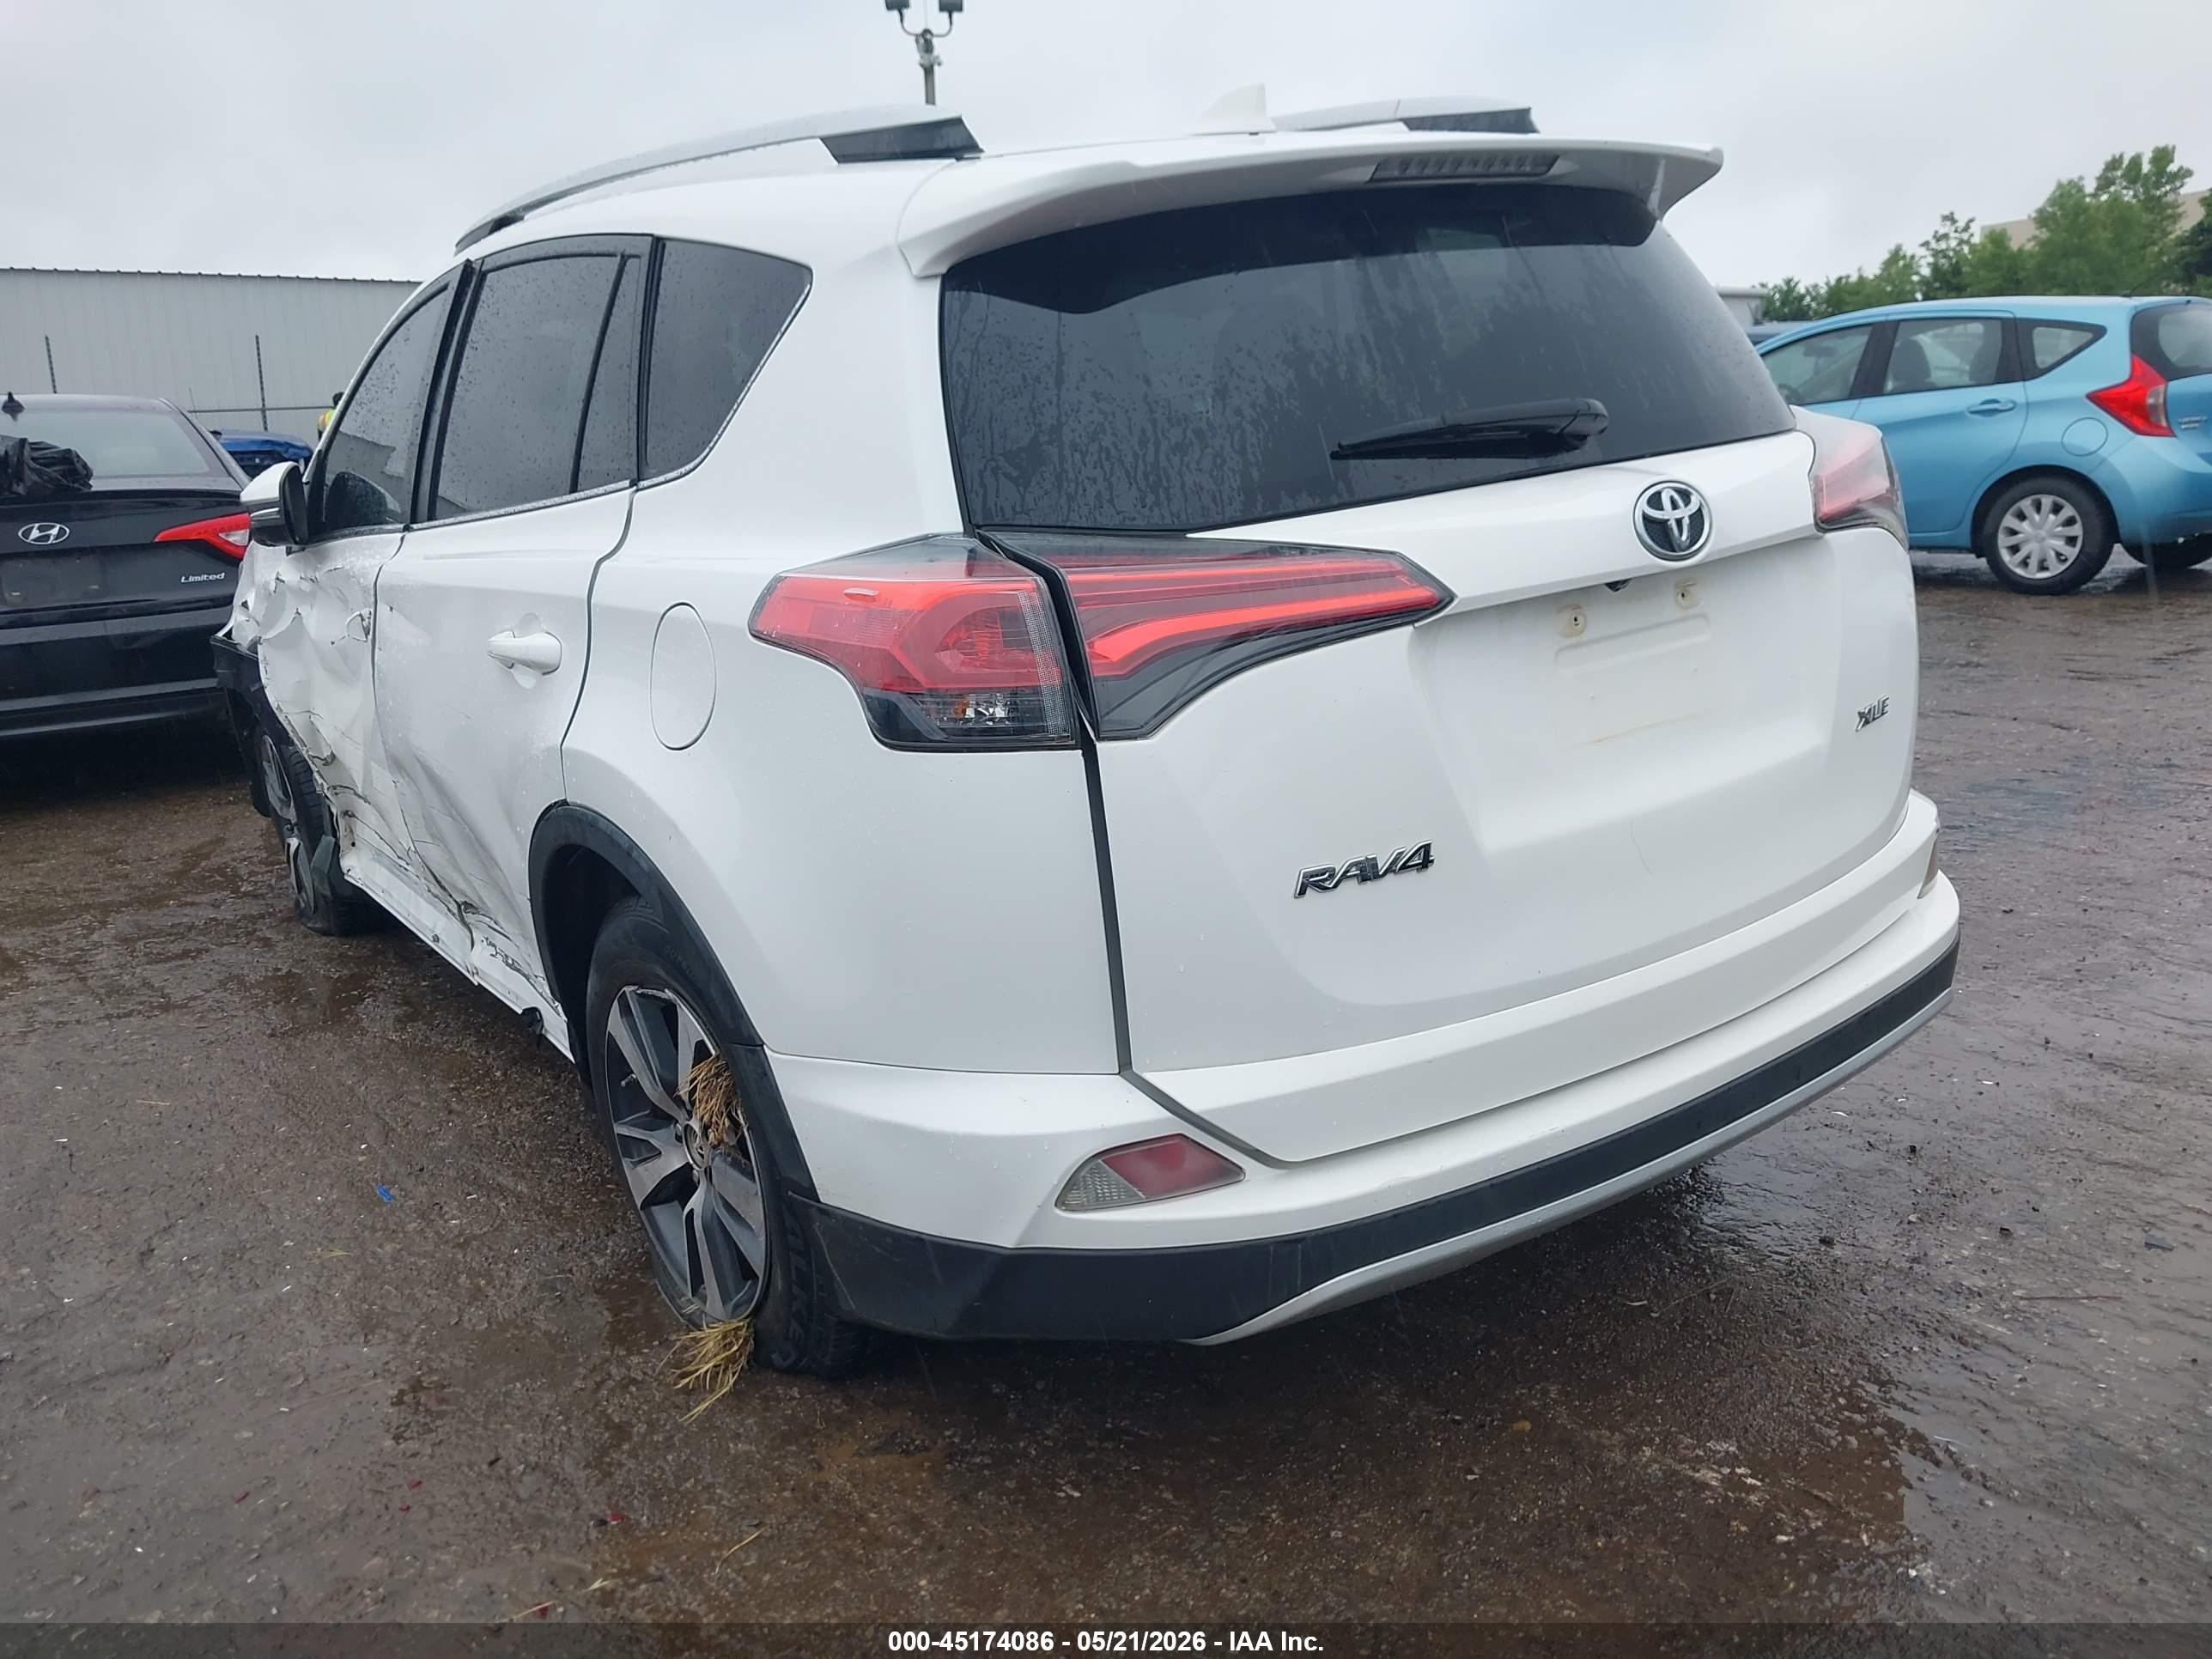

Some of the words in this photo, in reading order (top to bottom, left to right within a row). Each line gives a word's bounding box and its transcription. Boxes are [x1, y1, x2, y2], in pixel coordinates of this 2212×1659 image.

[180, 572, 225, 582] Limited
[1855, 694, 1890, 732] XLE
[1293, 838, 1436, 899] RAV4
